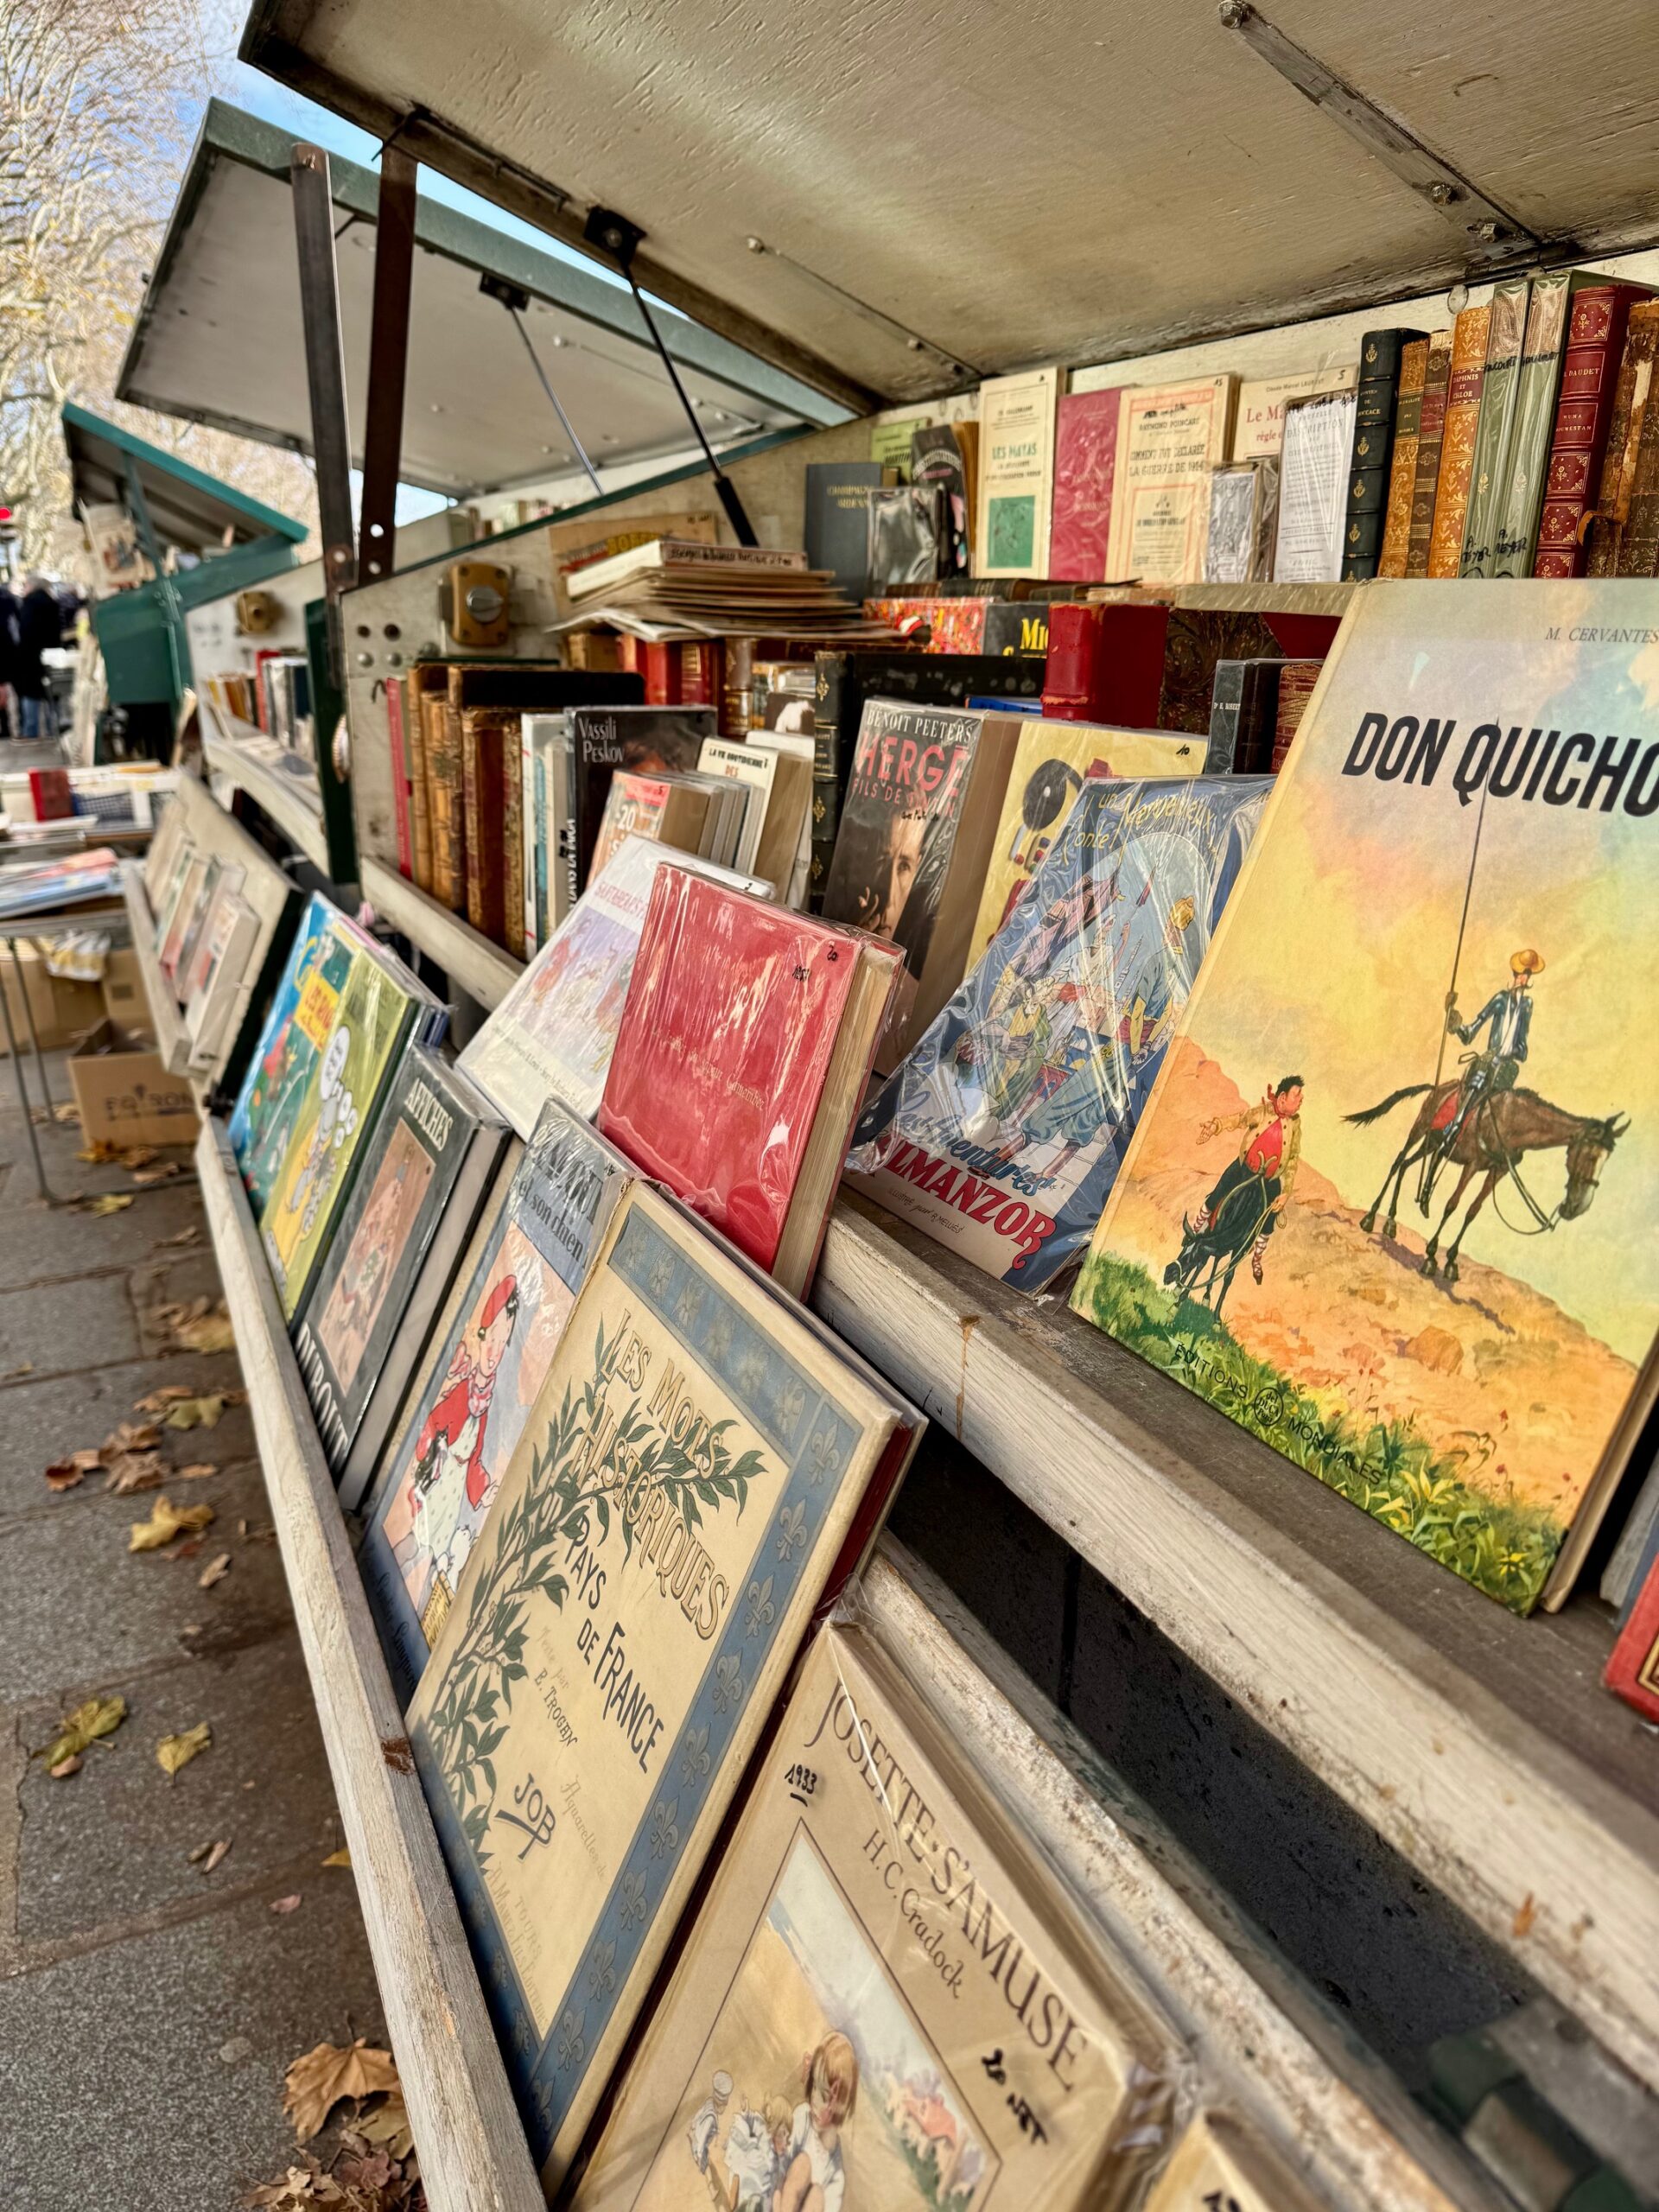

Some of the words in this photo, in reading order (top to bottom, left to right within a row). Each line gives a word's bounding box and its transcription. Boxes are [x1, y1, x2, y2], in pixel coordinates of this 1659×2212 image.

[1568, 366, 1601, 377] DAUDET
[1246, 408, 1263, 423] Le
[1545, 627, 1560, 641] M.
[1567, 626, 1659, 644] CERVANTES
[867, 709, 911, 733] BENOIT
[914, 716, 973, 743] PEETERS
[1176, 744, 1190, 756] 10
[852, 777, 878, 798] FILS
[884, 785, 902, 805] DE
[1341, 712, 1457, 786] DON
[1452, 722, 1659, 817] QUICHO
[404, 1077, 454, 1153] AFFICHES
[530, 1193, 553, 1226] son
[550, 1208, 584, 1263] chien
[601, 1308, 652, 1392] LES
[647, 1358, 723, 1481] MOTS
[1174, 1342, 1249, 1401] ÉDITIONS
[1257, 1397, 1281, 1418] DUCA
[1287, 1416, 1383, 1487] MONDIALES
[571, 1395, 731, 1642] HISTORIQUES
[565, 1505, 607, 1611] PAYS
[577, 1617, 601, 1667] DE
[593, 1621, 664, 1774] FRANCE
[497, 1772, 558, 1861] JOB
[784, 1763, 817, 1795] 1933
[803, 1680, 937, 1864] JOSETTE
[931, 1846, 1089, 2093] S'AMUSE
[513, 1896, 544, 1961] TOURS
[900, 1887, 965, 1999] Cradock
